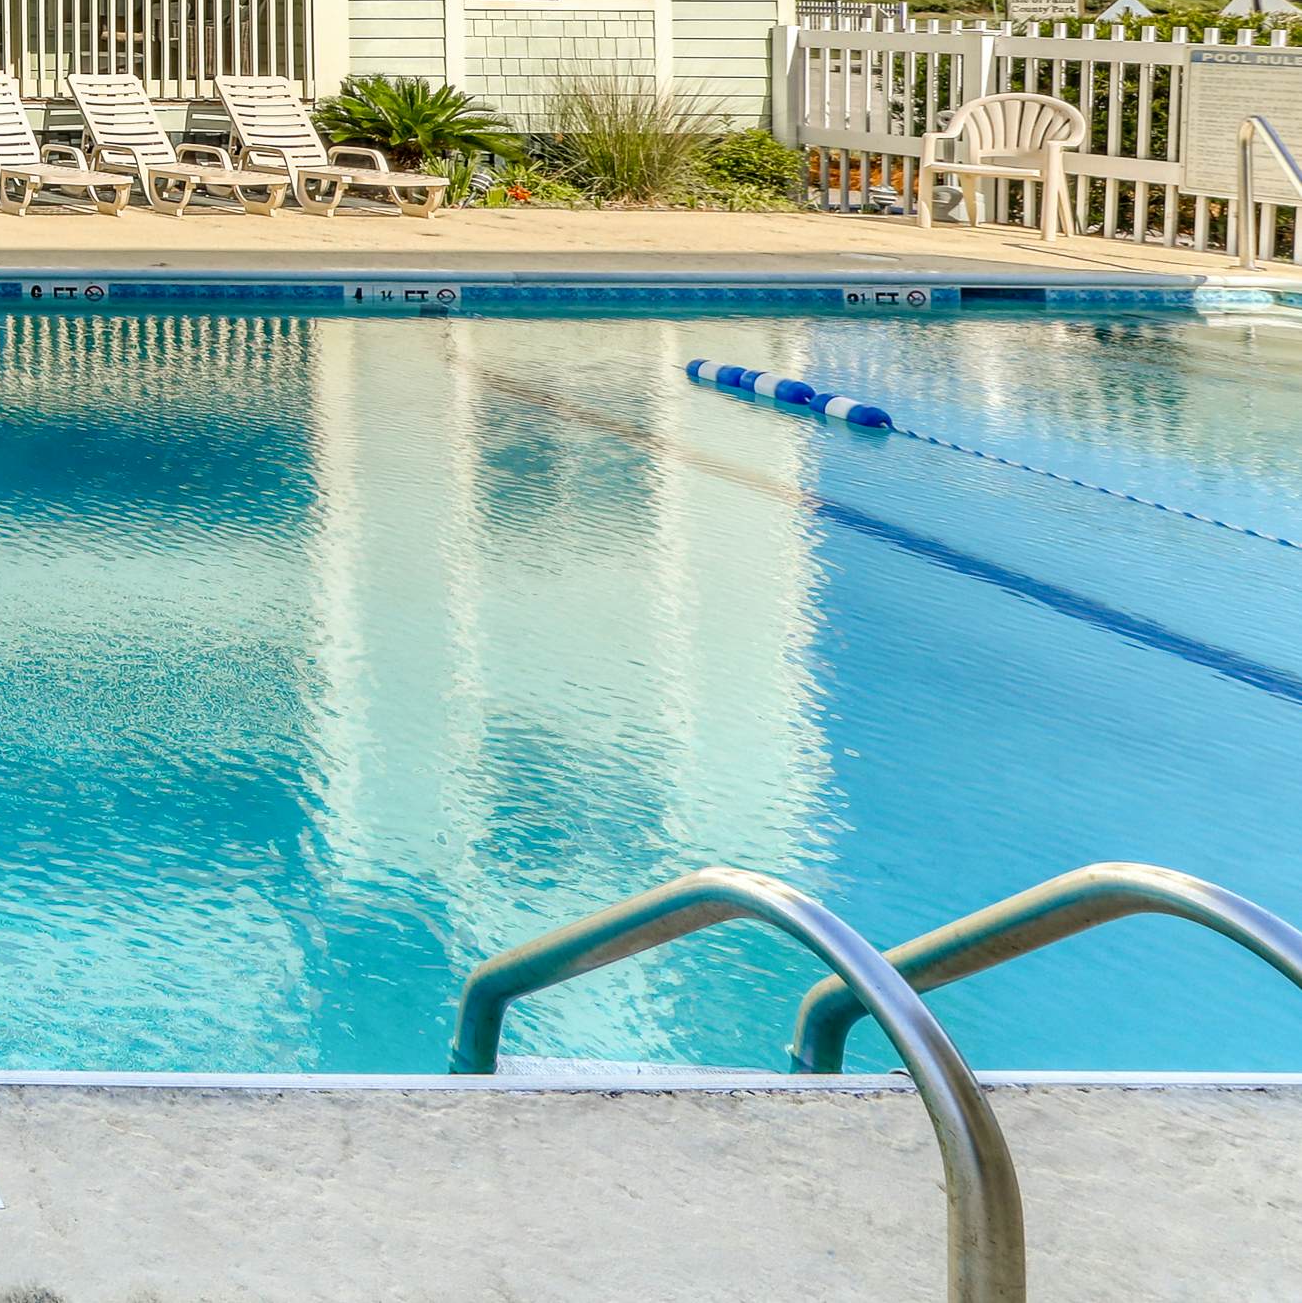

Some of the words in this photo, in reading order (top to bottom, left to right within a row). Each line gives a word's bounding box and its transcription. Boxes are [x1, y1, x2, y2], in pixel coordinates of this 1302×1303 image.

[1011, 5, 1052, 15] County
[1201, 53, 1252, 64] POOL
[1256, 55, 1302, 67] RULE
